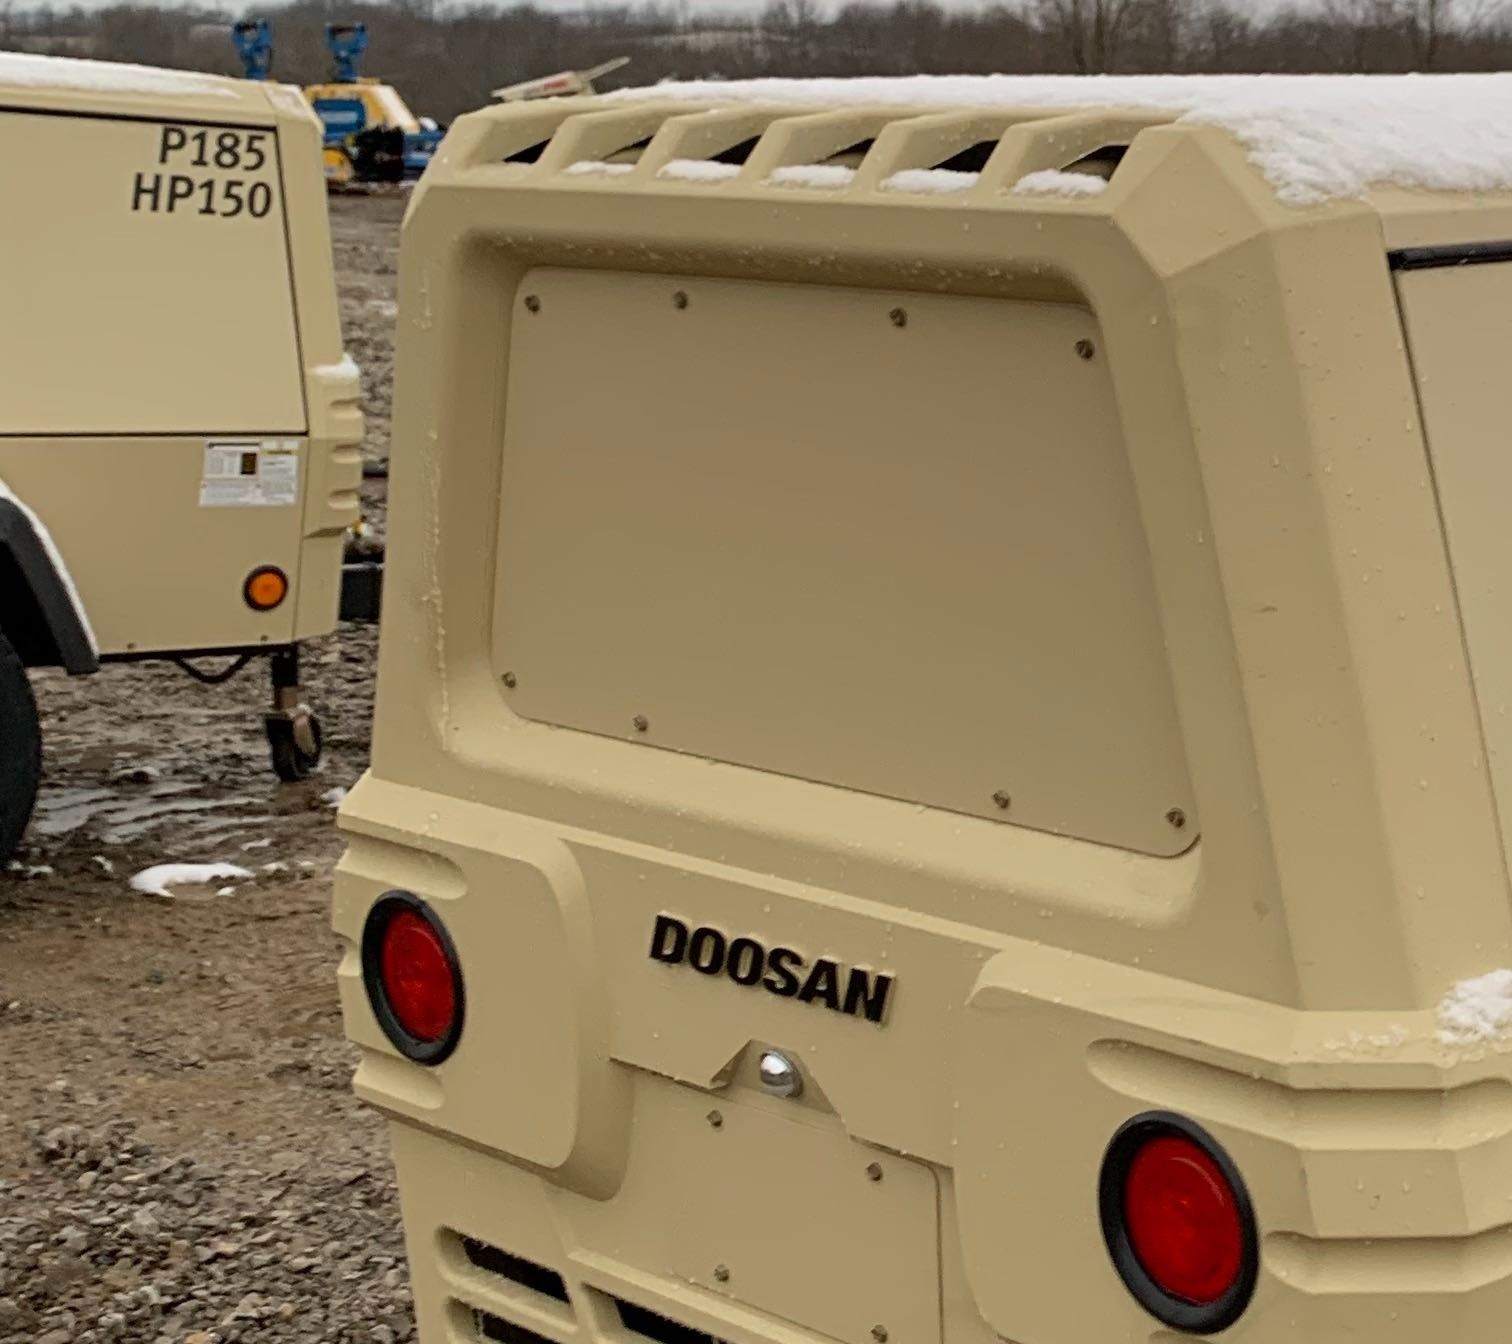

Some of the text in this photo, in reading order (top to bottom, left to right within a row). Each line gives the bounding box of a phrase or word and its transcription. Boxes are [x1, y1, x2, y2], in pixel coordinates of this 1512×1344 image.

[159, 126, 266, 172] P185
[131, 172, 272, 218] HP150
[649, 913, 895, 1024] DOOSAN
